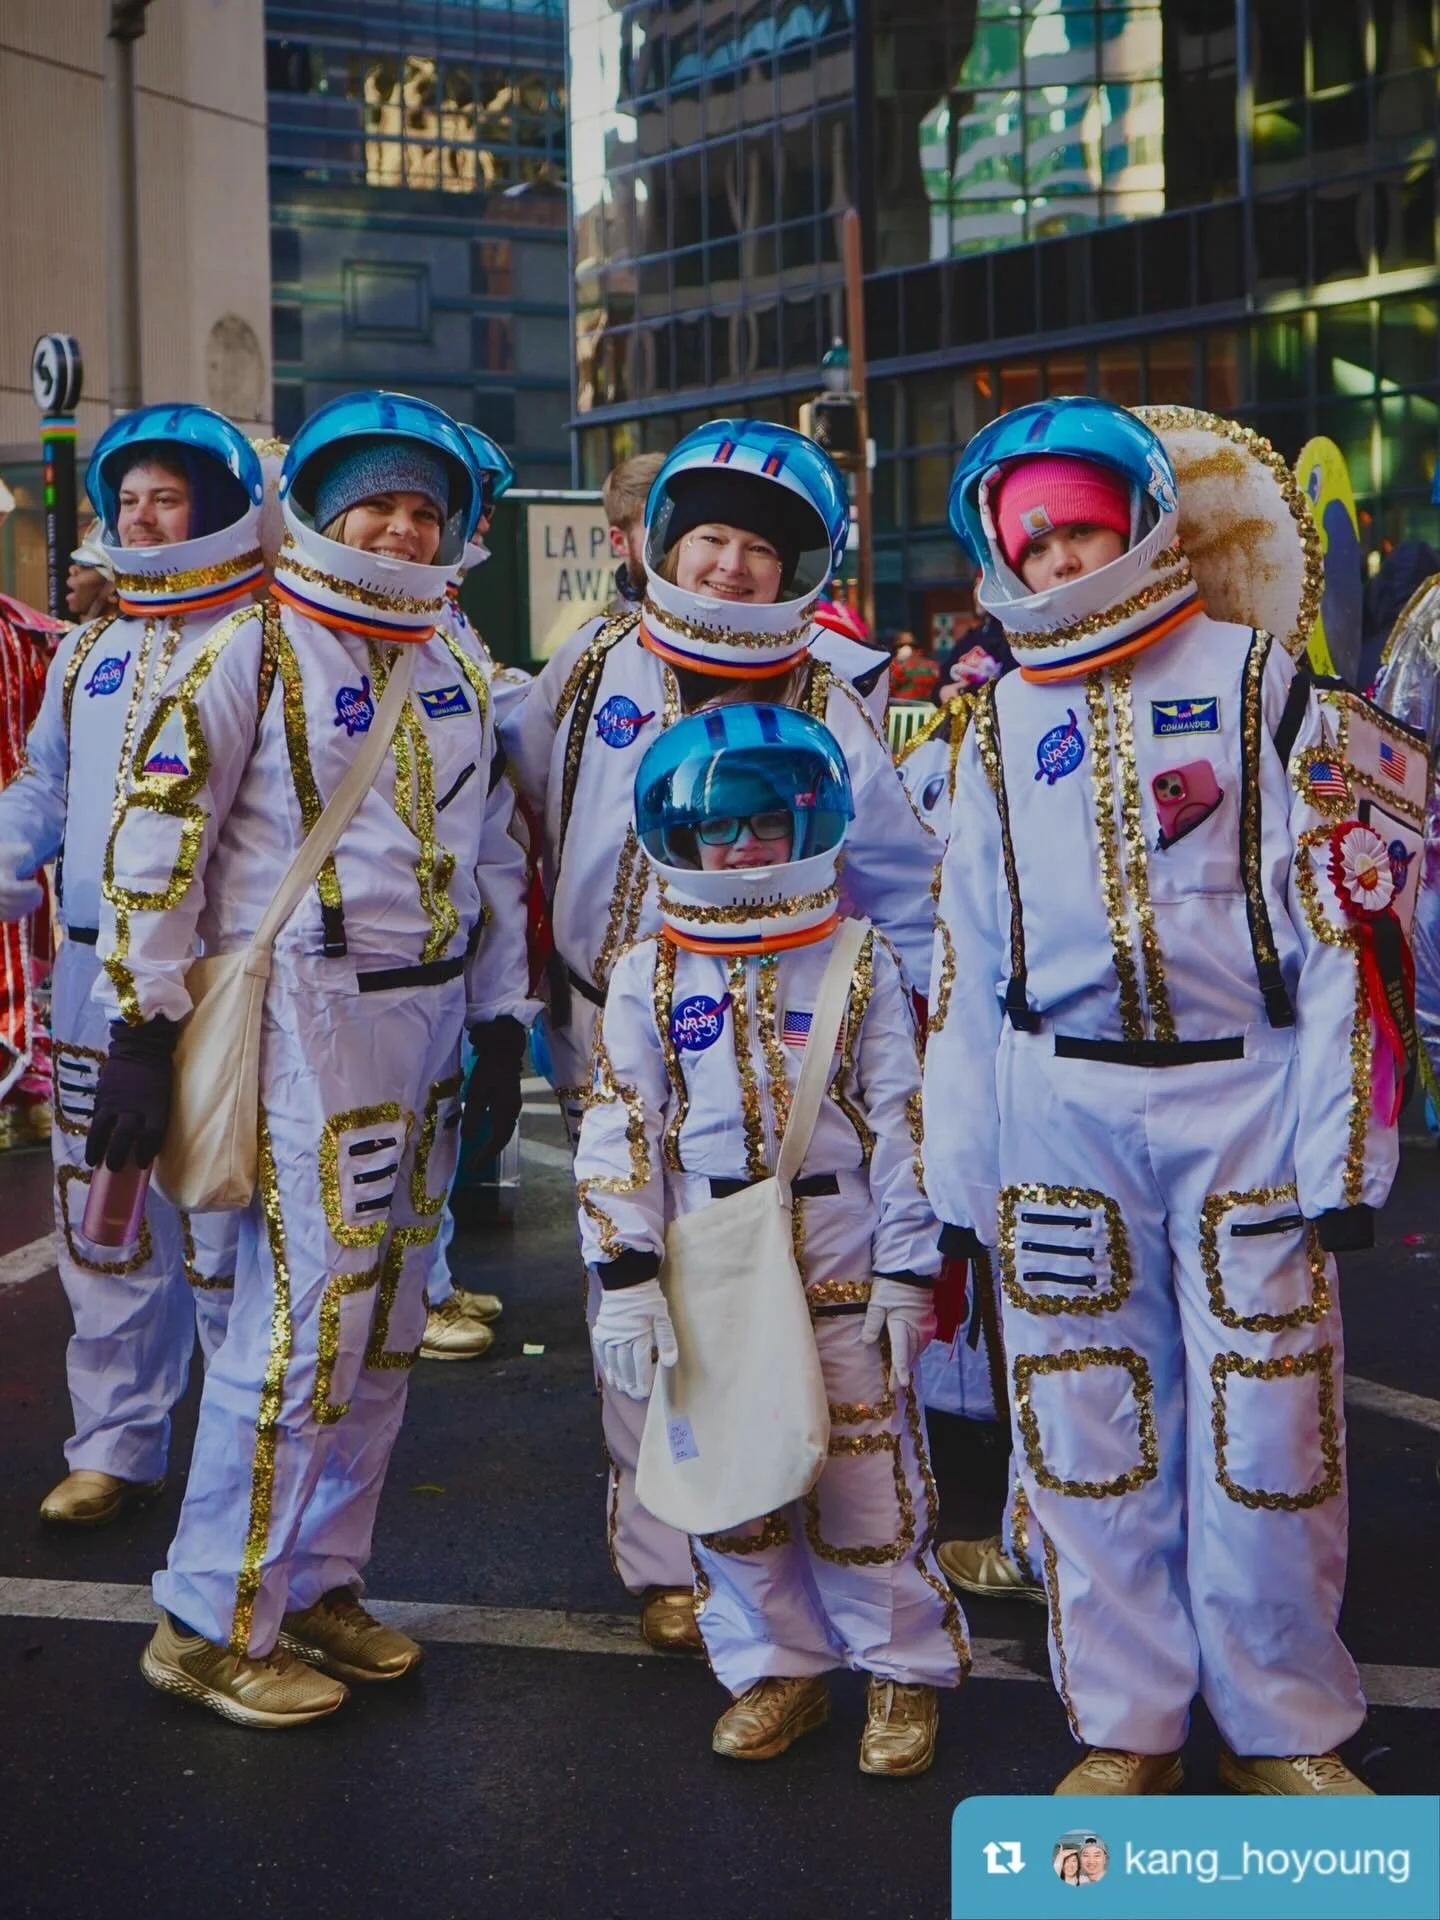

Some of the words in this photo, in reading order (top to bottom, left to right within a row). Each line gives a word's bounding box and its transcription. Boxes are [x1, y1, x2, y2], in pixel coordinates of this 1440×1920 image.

[545, 526, 577, 558] LA
[341, 701, 370, 719] NASA
[1160, 720, 1211, 732] COMMANDER
[1041, 735, 1080, 768] NASA
[675, 1015, 718, 1032] NASA
